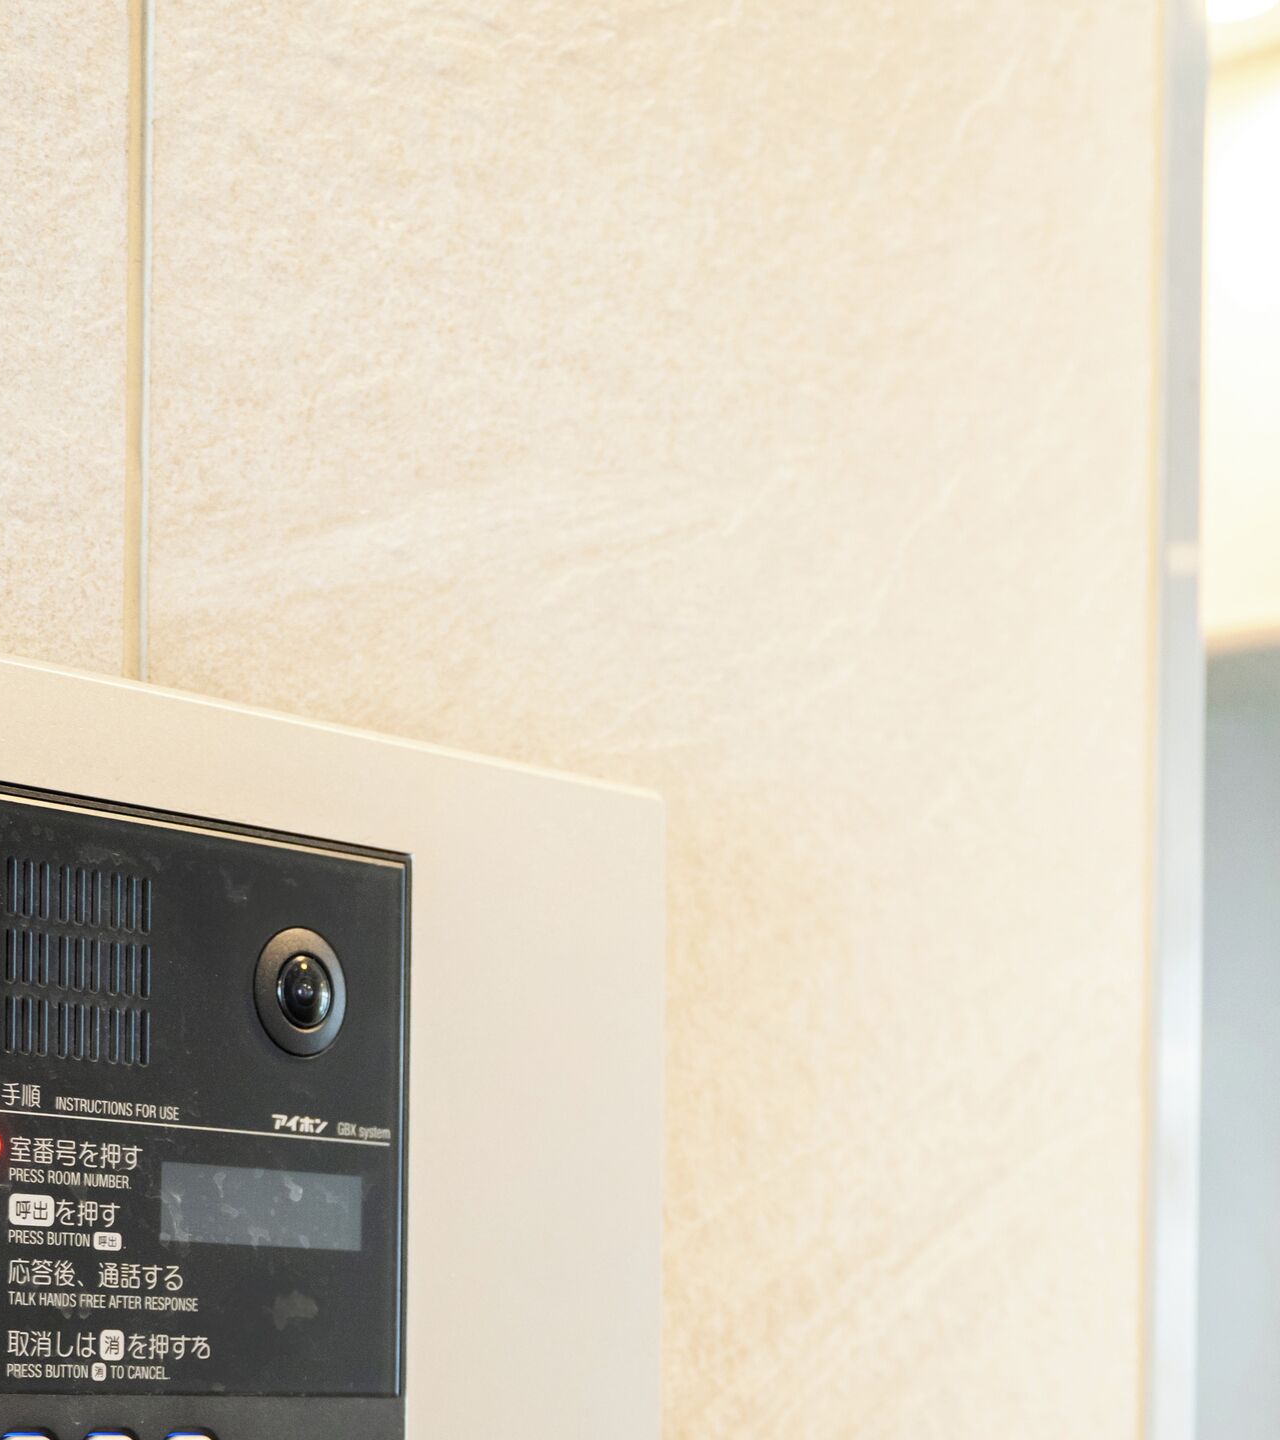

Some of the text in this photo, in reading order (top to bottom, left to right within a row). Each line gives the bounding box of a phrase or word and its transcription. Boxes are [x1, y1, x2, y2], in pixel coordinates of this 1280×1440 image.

[55, 1096, 133, 1117] INSTRUCTIONS
[135, 1103, 157, 1119] FOR
[158, 1106, 180, 1121] USE
[271, 1114, 328, 1134] アイホン
[337, 1122, 391, 1140] GBX system
[9, 1136, 143, 1171] 室番号を押す
[9, 1168, 132, 1190] PRESS ROOM NUMBER.
[8, 1229, 44, 1245] PRESS
[47, 1231, 91, 1248] BUTTON
[8, 1290, 199, 1312] TALK HANDS FREE AFTER RESPONSE
[7, 1363, 42, 1378] PRESS
[45, 1364, 89, 1379] BUTTON
[110, 1365, 125, 1379] TO
